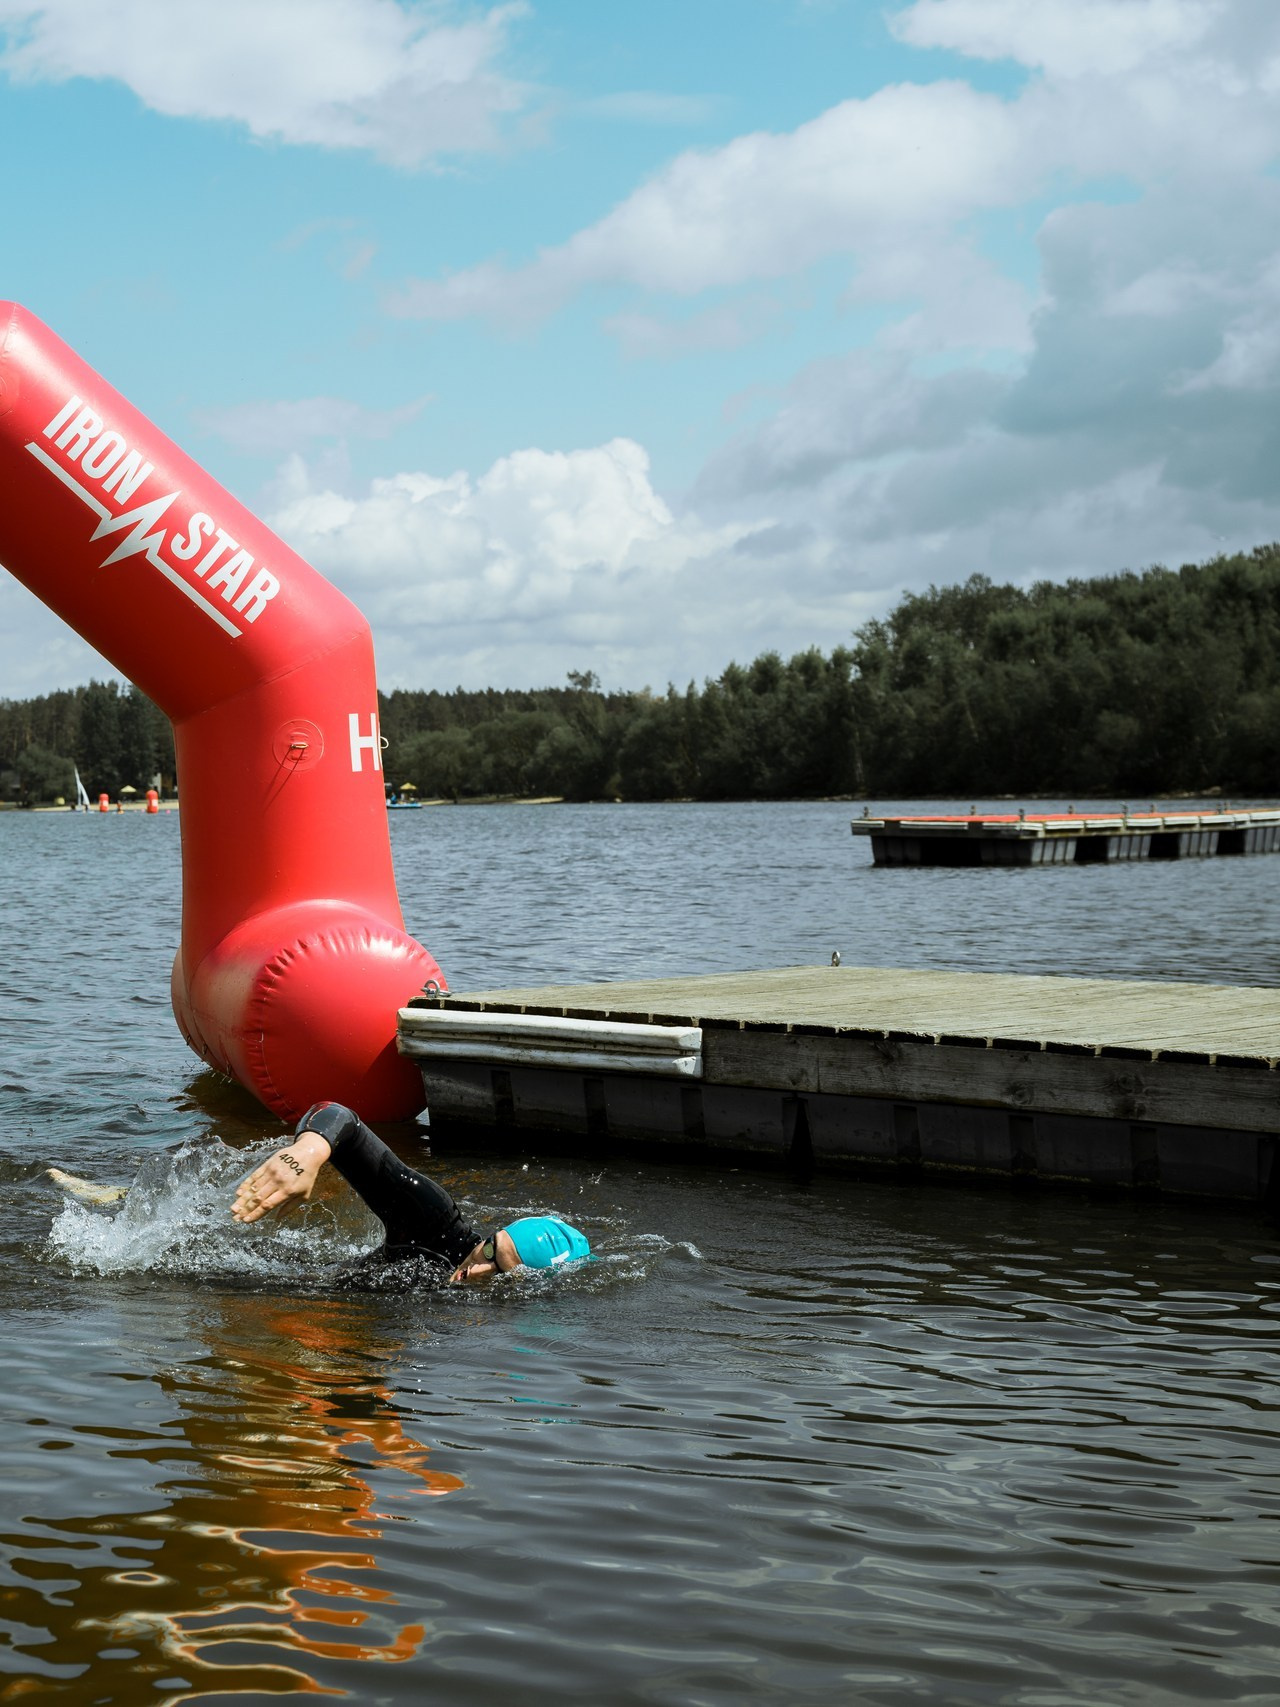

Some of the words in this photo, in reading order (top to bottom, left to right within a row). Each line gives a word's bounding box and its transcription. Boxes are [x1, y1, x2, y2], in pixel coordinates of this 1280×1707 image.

[42, 396, 155, 505] IRON
[170, 512, 281, 624] STAR
[348, 712, 382, 772] H
[279, 1153, 305, 1176] 4004
